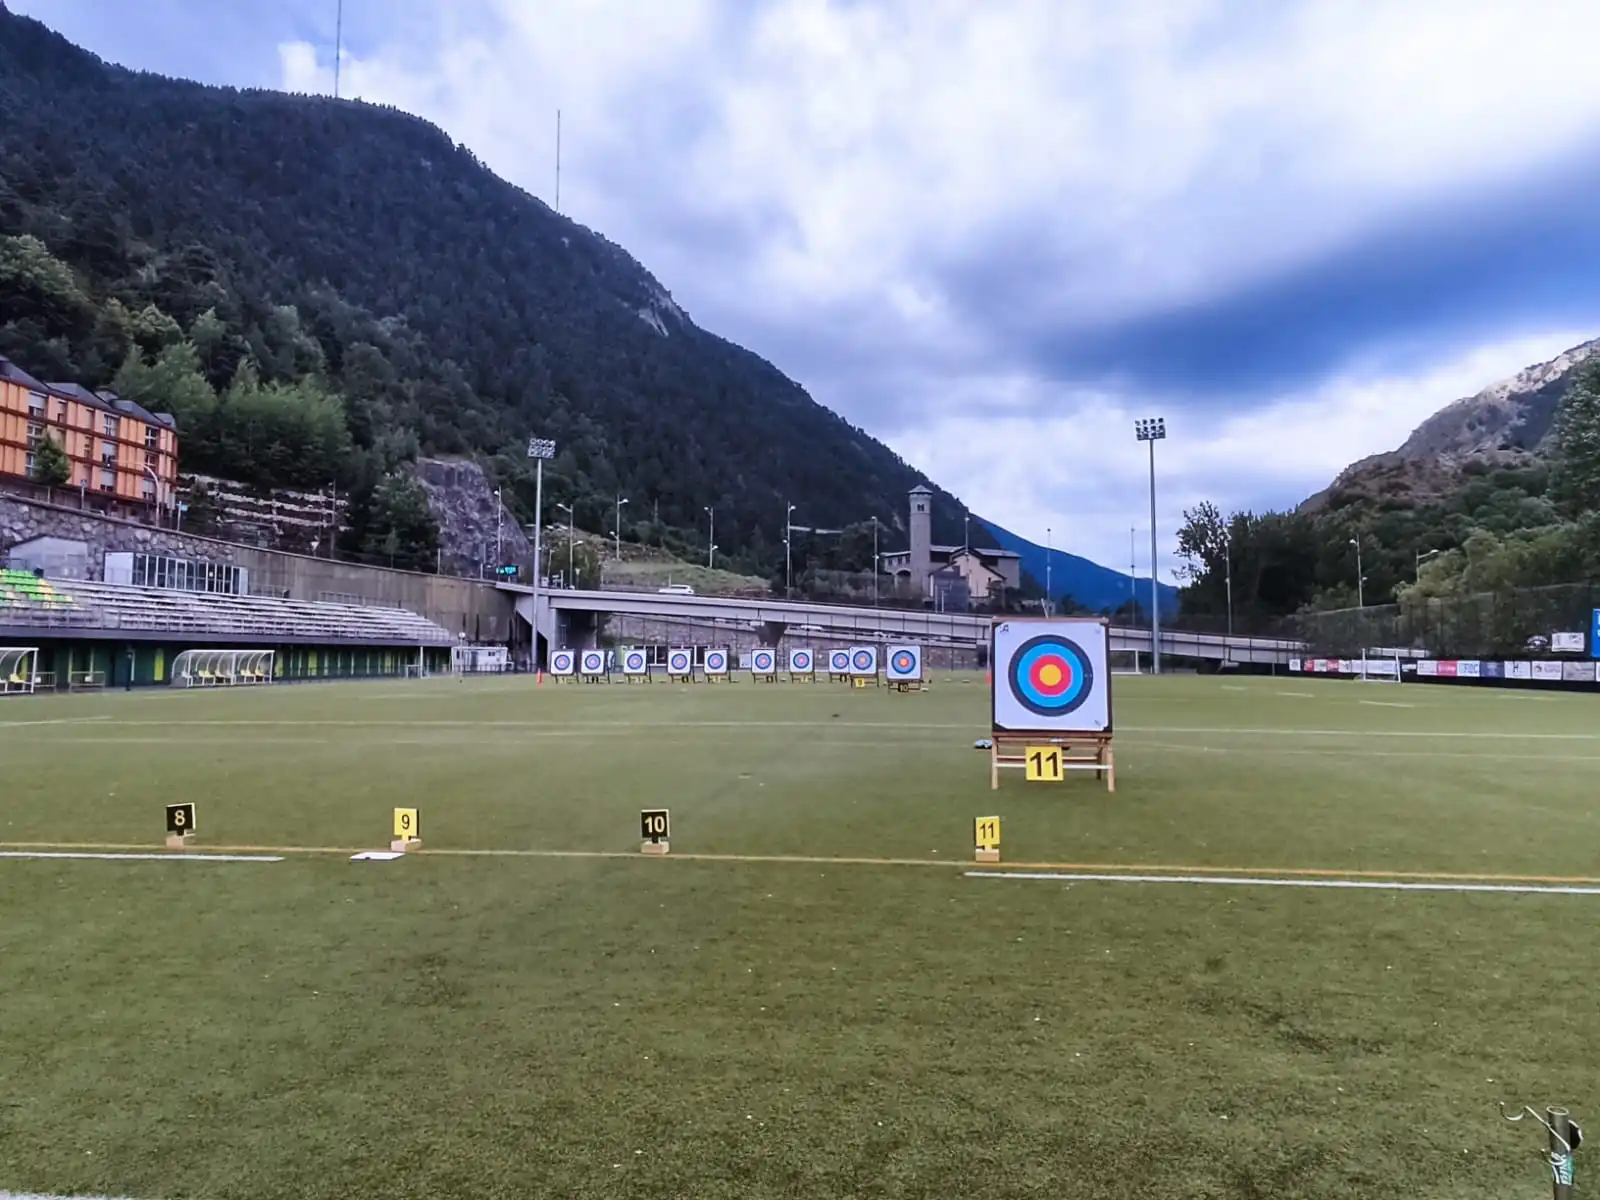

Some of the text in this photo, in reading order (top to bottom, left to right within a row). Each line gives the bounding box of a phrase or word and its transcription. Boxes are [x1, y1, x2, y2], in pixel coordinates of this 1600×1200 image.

[1030, 751, 1058, 777] 11
[174, 810, 186, 826] 8
[401, 814, 410, 830] 9
[644, 815, 665, 833] 10
[980, 822, 994, 839] 11
